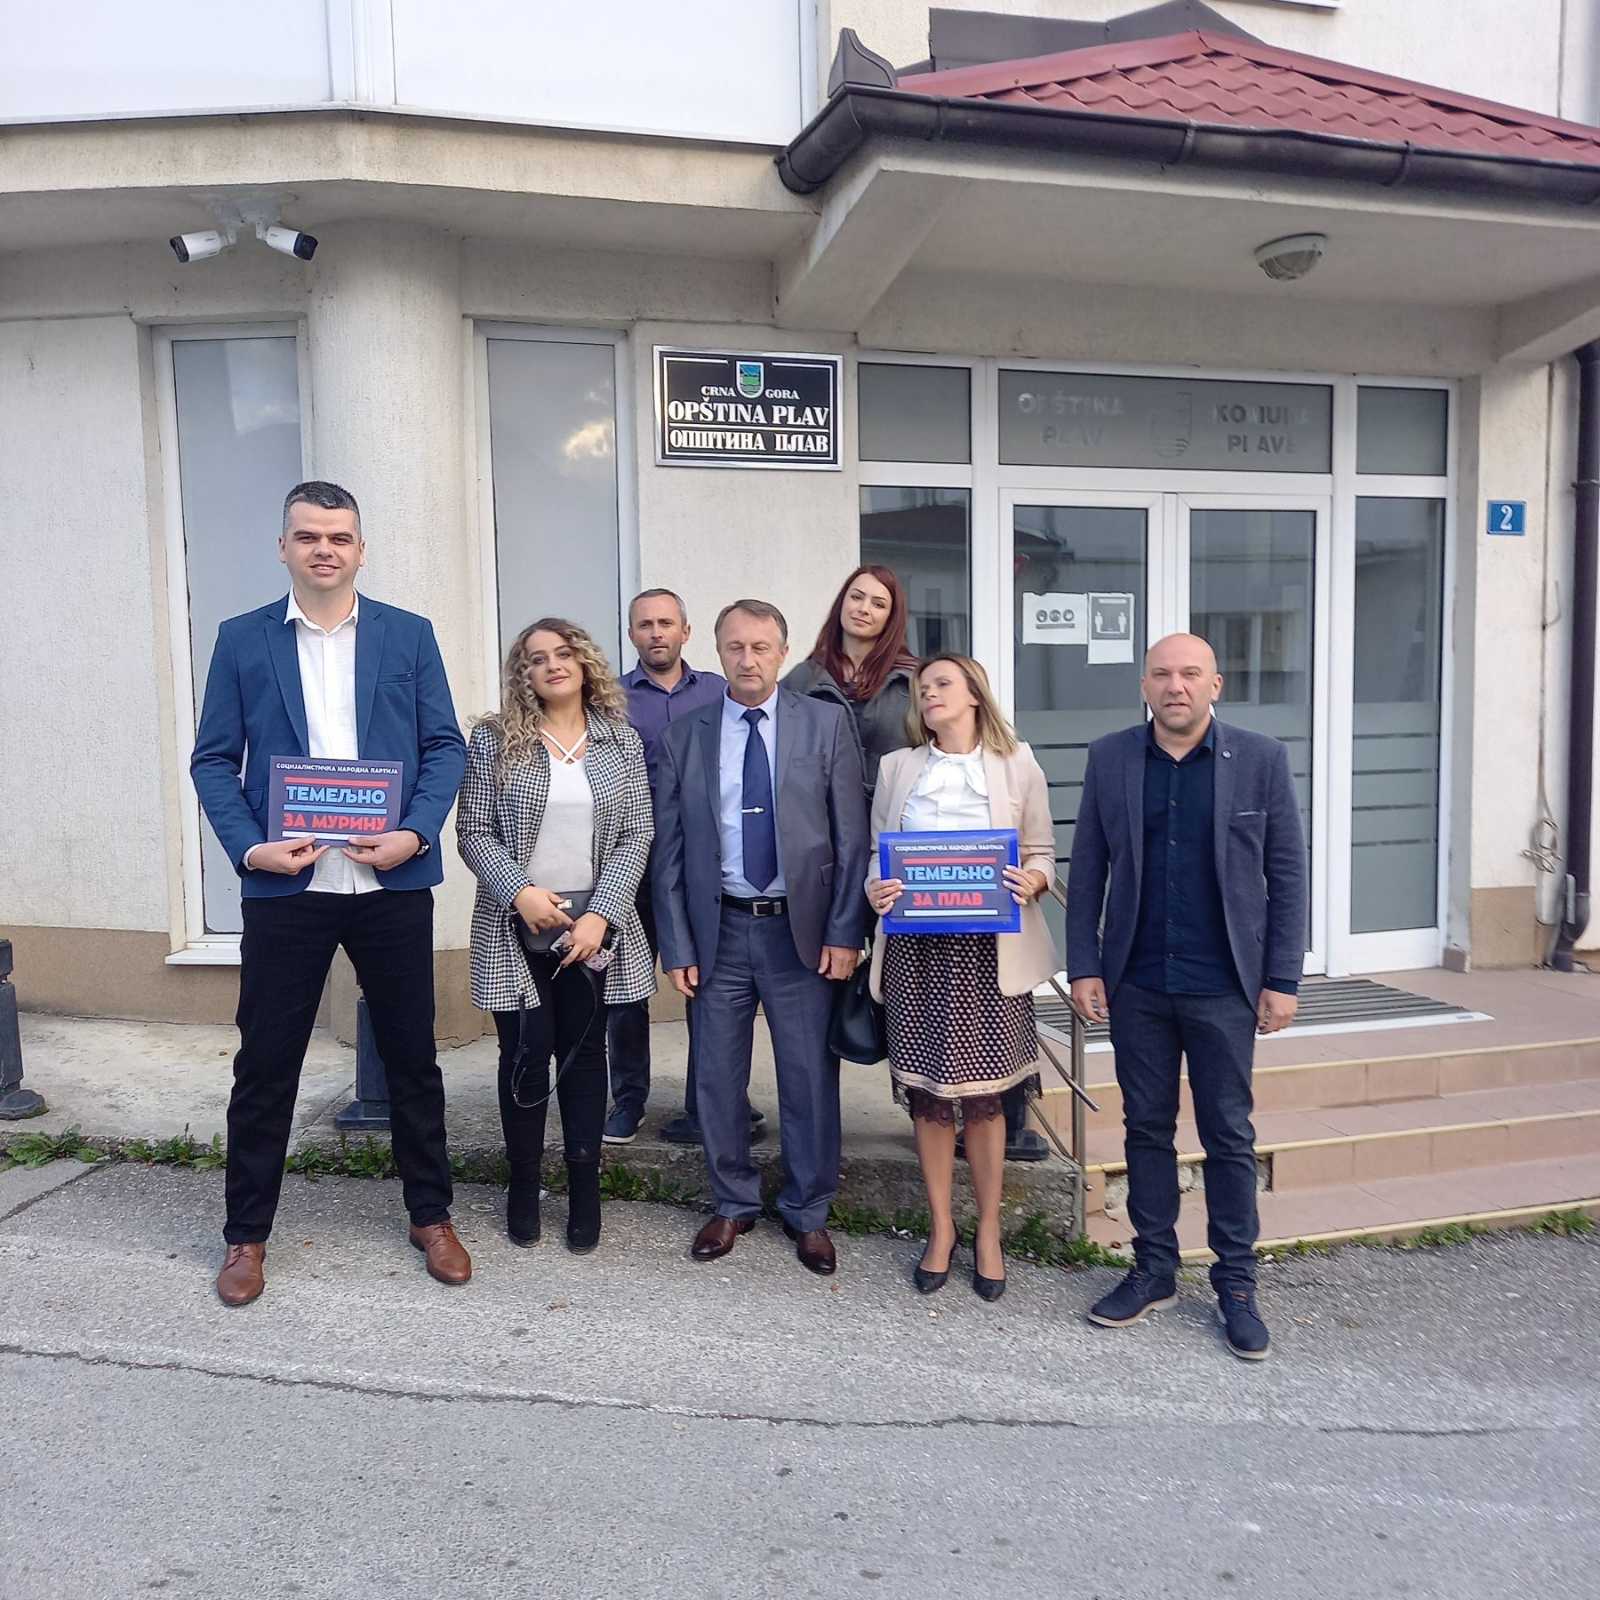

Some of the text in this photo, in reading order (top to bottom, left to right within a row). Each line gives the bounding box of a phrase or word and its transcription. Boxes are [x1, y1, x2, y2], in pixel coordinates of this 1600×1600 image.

[701, 385, 800, 400] CRNA GORA
[668, 396, 829, 426] OPŠTINA PLAV
[669, 430, 829, 453] ОПШТИНА ПЛАВ
[1500, 504, 1513, 531] 2
[337, 765, 369, 774] НАРОДНА
[370, 767, 399, 775] ПАРТИЈА
[286, 785, 386, 804] ТЕМЕЉНО
[282, 813, 388, 831] ЗА МУРИНУ
[904, 865, 995, 880] ТЕМЕЉНО
[912, 892, 983, 906] ЗА ПЛАВ
